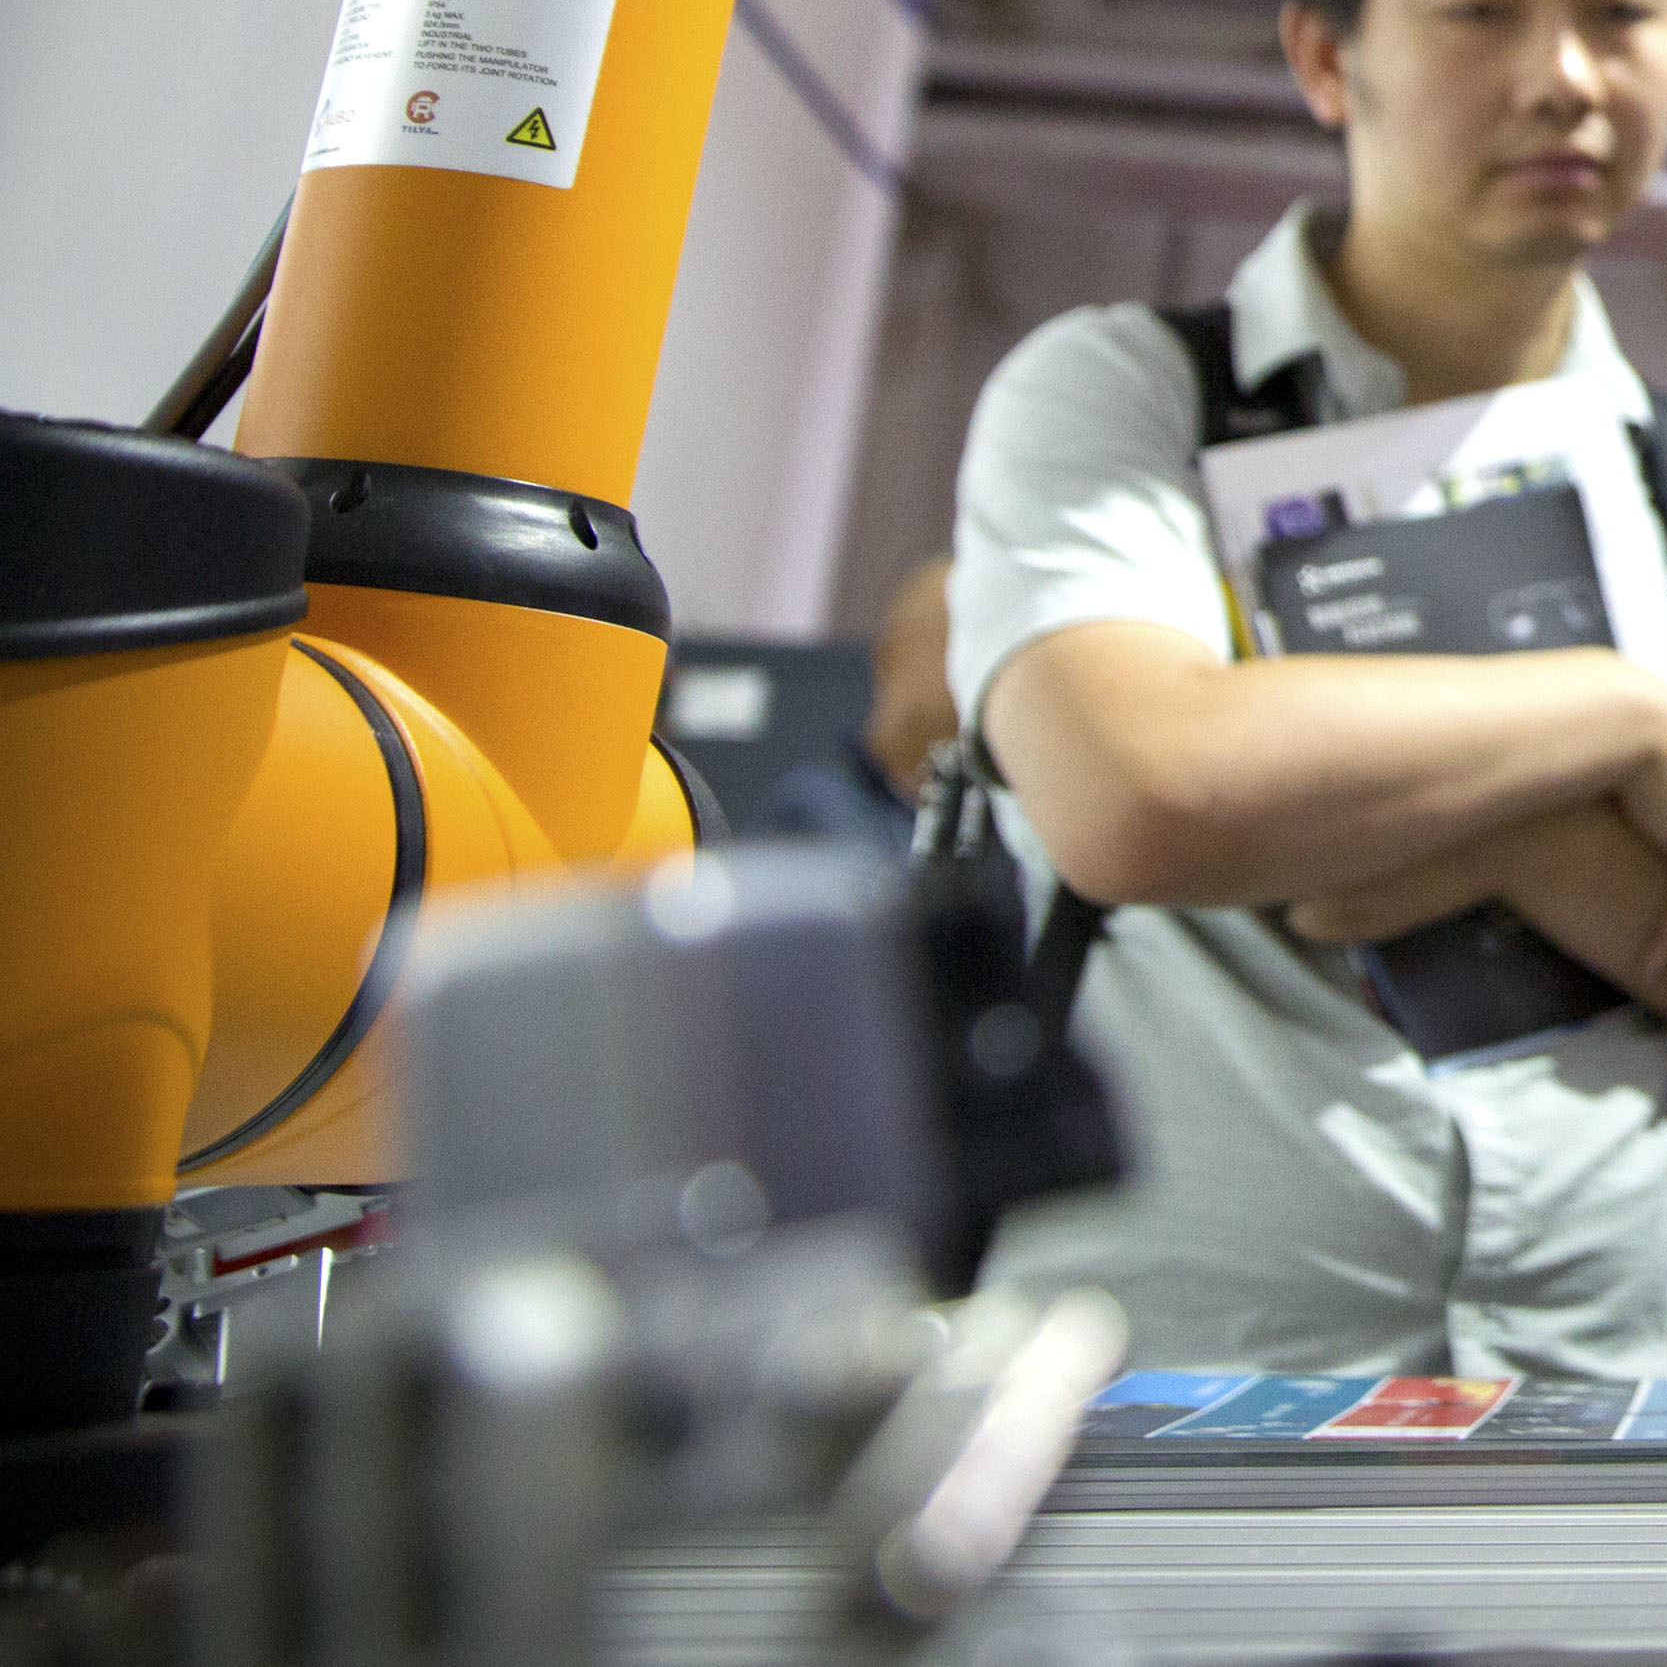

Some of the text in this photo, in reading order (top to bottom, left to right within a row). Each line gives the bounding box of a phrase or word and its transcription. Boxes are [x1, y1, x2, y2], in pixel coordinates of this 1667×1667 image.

[420, 30, 473, 42] INDUSTRIAL
[450, 40, 469, 51] THE
[472, 43, 494, 54] TWO
[496, 46, 529, 59] TUBES
[415, 50, 550, 75] PUSHING THE MANIPULATOR
[426, 61, 459, 72] FORCE
[460, 63, 477, 74] ITS
[478, 66, 506, 78] JOINT
[506, 70, 558, 87] ROTATION
